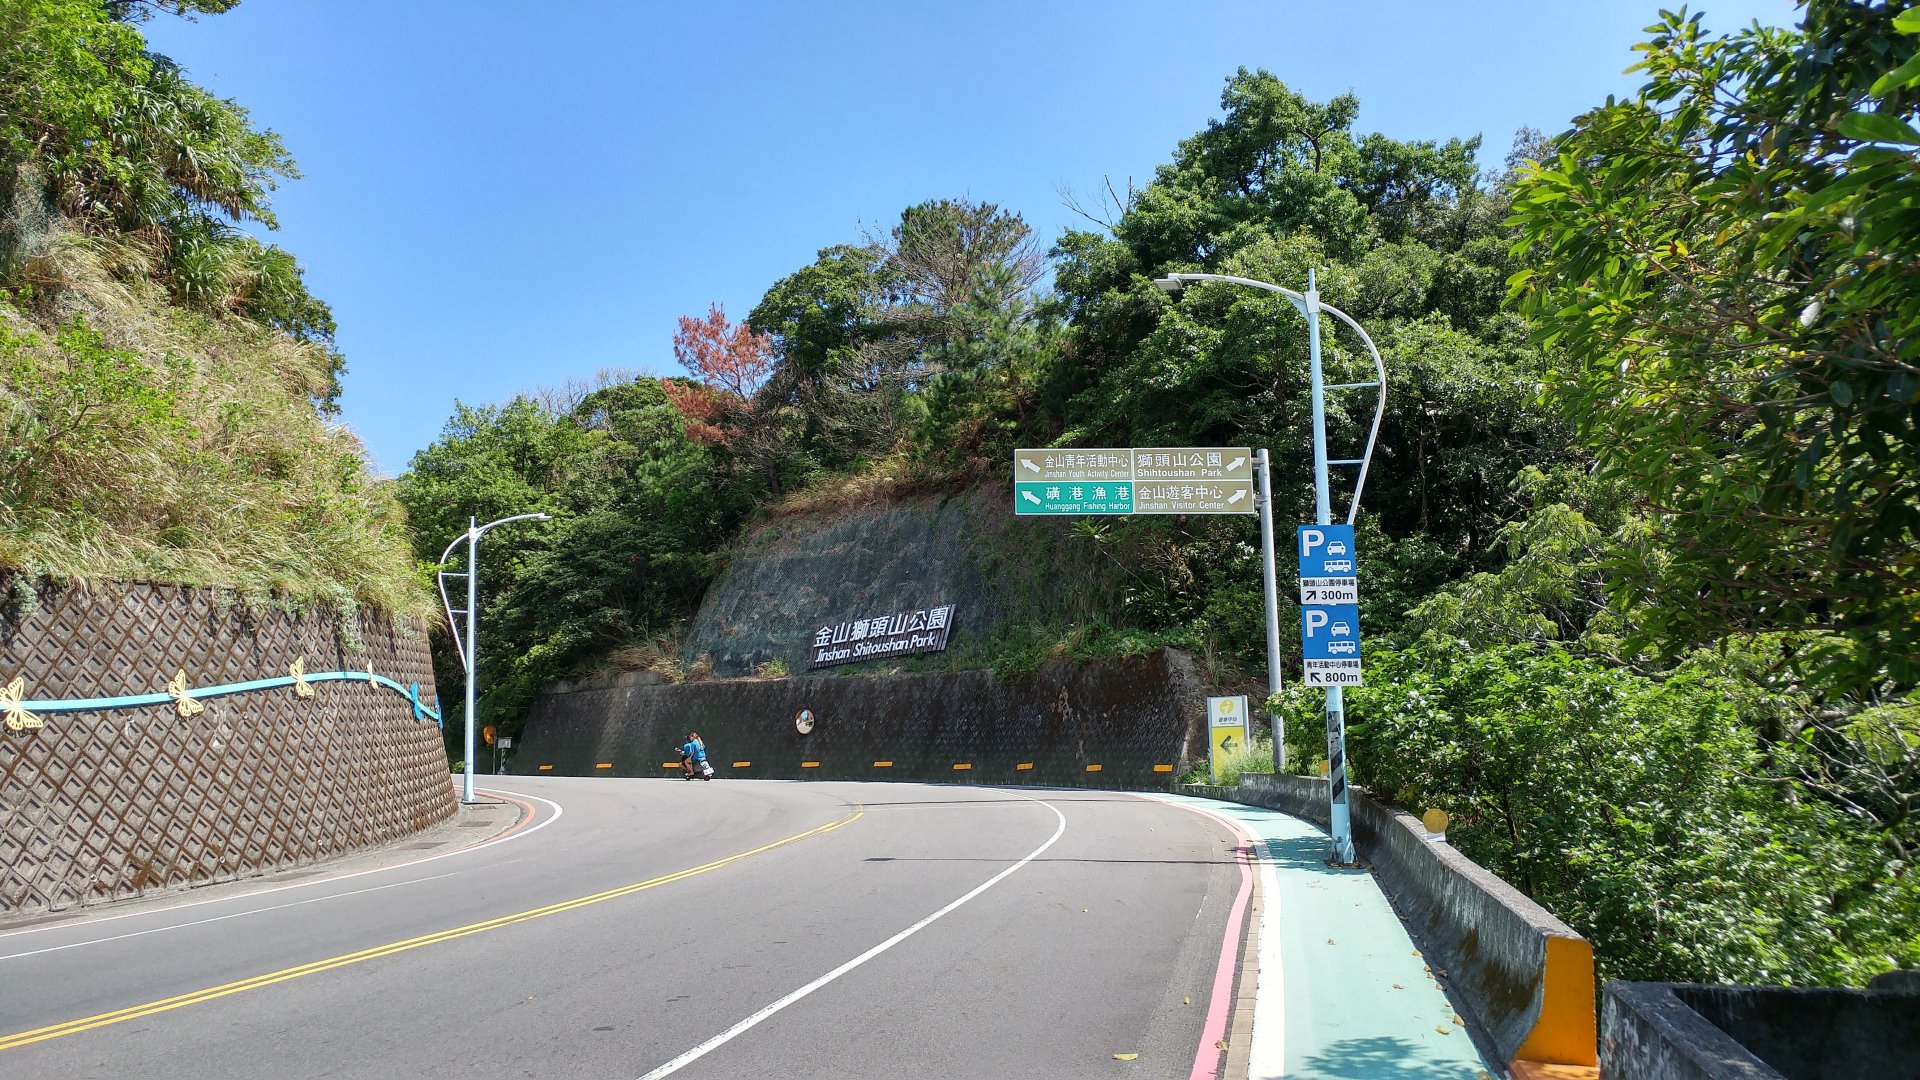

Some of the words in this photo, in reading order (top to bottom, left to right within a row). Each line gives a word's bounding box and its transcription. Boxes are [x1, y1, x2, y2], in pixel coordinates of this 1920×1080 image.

[1044, 454, 1129, 468] 金山青年活動中心
[1137, 452, 1222, 467] 獅頭山公園
[1044, 470, 1066, 478] Jinshan
[1068, 470, 1085, 478] Youth
[1087, 470, 1108, 479] Activity
[1110, 469, 1129, 478] Center
[1137, 468, 1196, 477] Shihtoushan
[1201, 468, 1223, 477] Park
[1045, 486, 1130, 500] 磺港漁港
[1138, 485, 1223, 500] 金山遊客中心
[1045, 502, 1080, 512] Huanggang
[1083, 502, 1106, 512] Fishing
[1108, 502, 1130, 510] Harbor
[1139, 502, 1168, 510] Jinshan
[1171, 501, 1196, 509] Visitor
[1199, 501, 1224, 509] Center
[1302, 529, 1325, 557] P
[1321, 590, 1353, 600] 300m
[813, 606, 949, 648] 金山獅頭山公園
[1305, 609, 1329, 638] P
[815, 647, 851, 663] Jinshan
[853, 637, 909, 658] Shitoushan
[910, 632, 936, 651] Park
[1325, 672, 1358, 682] 800m
